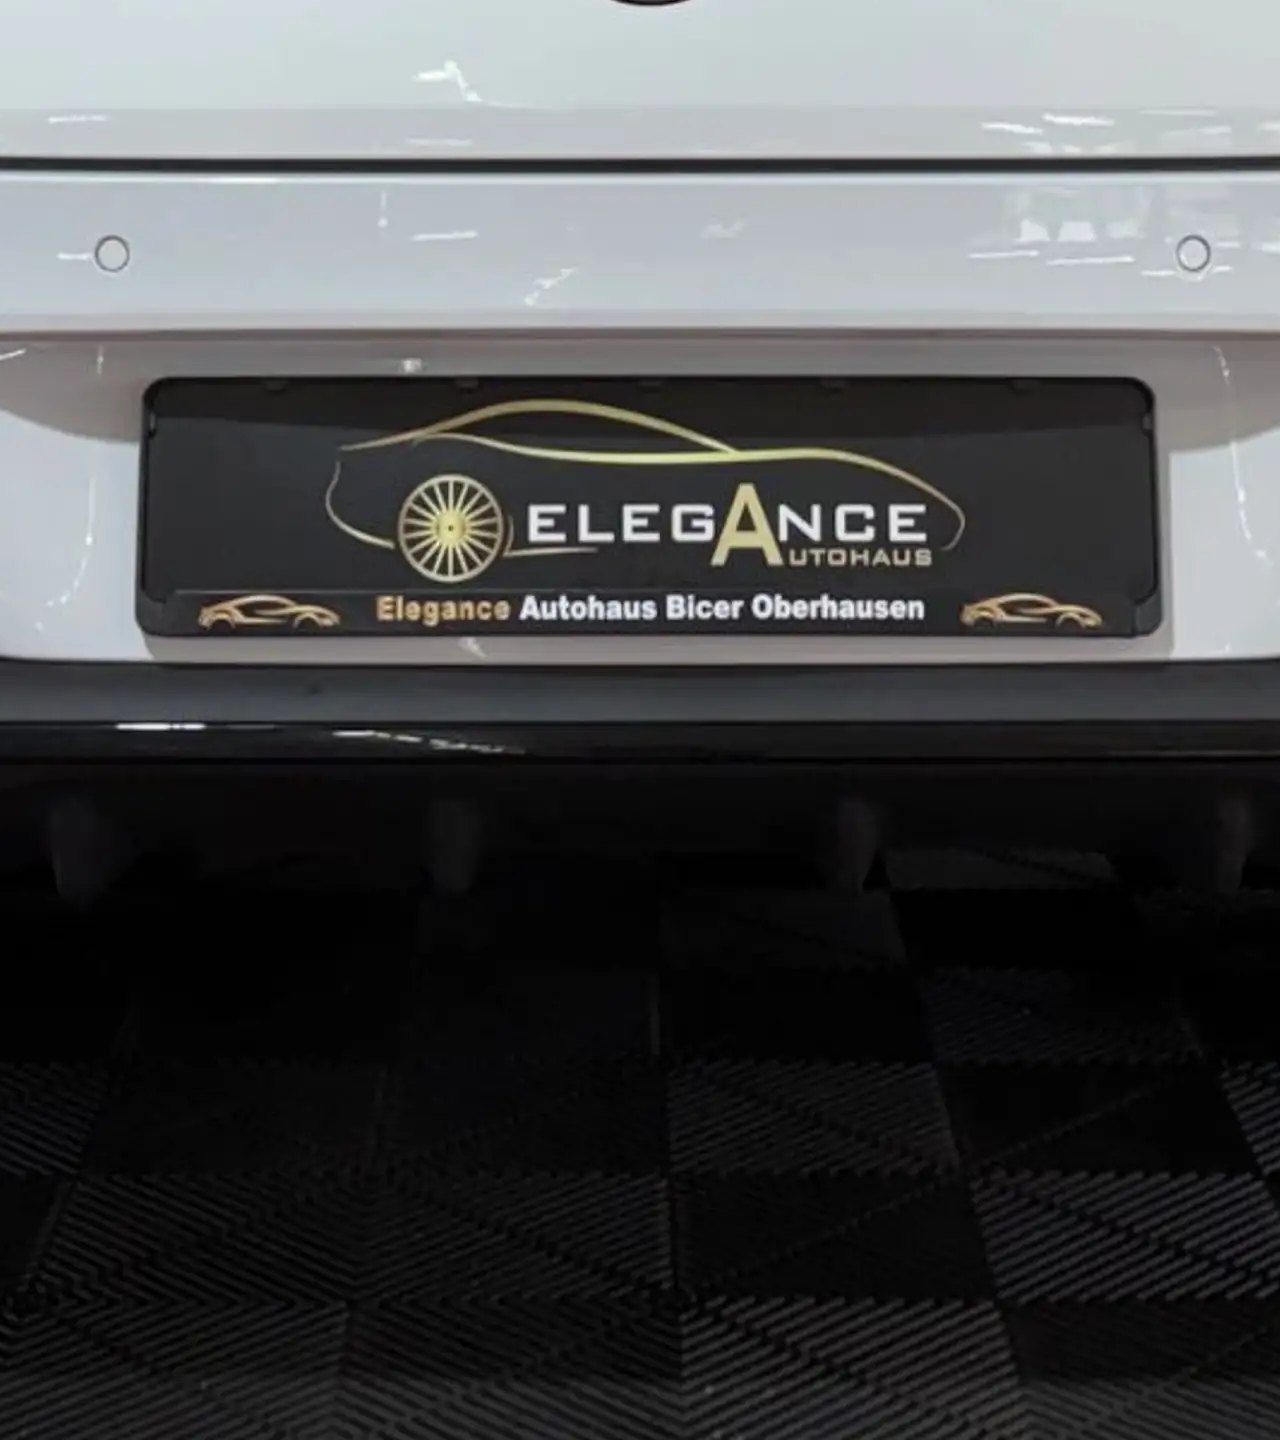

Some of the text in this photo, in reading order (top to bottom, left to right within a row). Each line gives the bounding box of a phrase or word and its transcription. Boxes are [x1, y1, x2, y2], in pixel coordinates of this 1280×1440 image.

[527, 482, 928, 567] ELEGANCE
[375, 593, 926, 626] Elegance Autohaus Bicer Oberhausen
